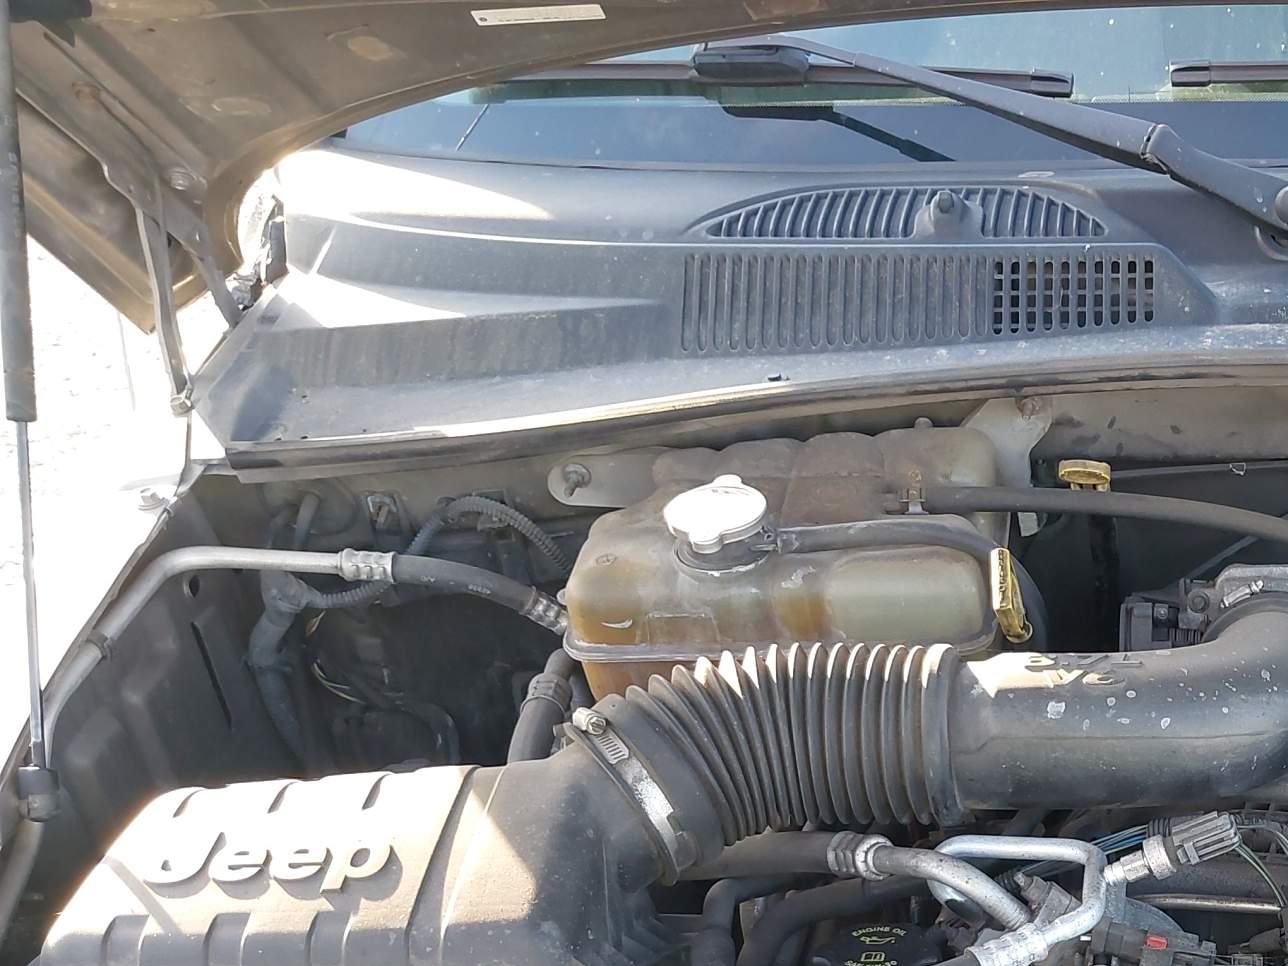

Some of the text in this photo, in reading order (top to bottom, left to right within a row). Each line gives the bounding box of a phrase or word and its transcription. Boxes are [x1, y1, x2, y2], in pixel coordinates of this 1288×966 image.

[140, 828, 402, 896] Jeep
[852, 926, 907, 936] ENGINE OIL
